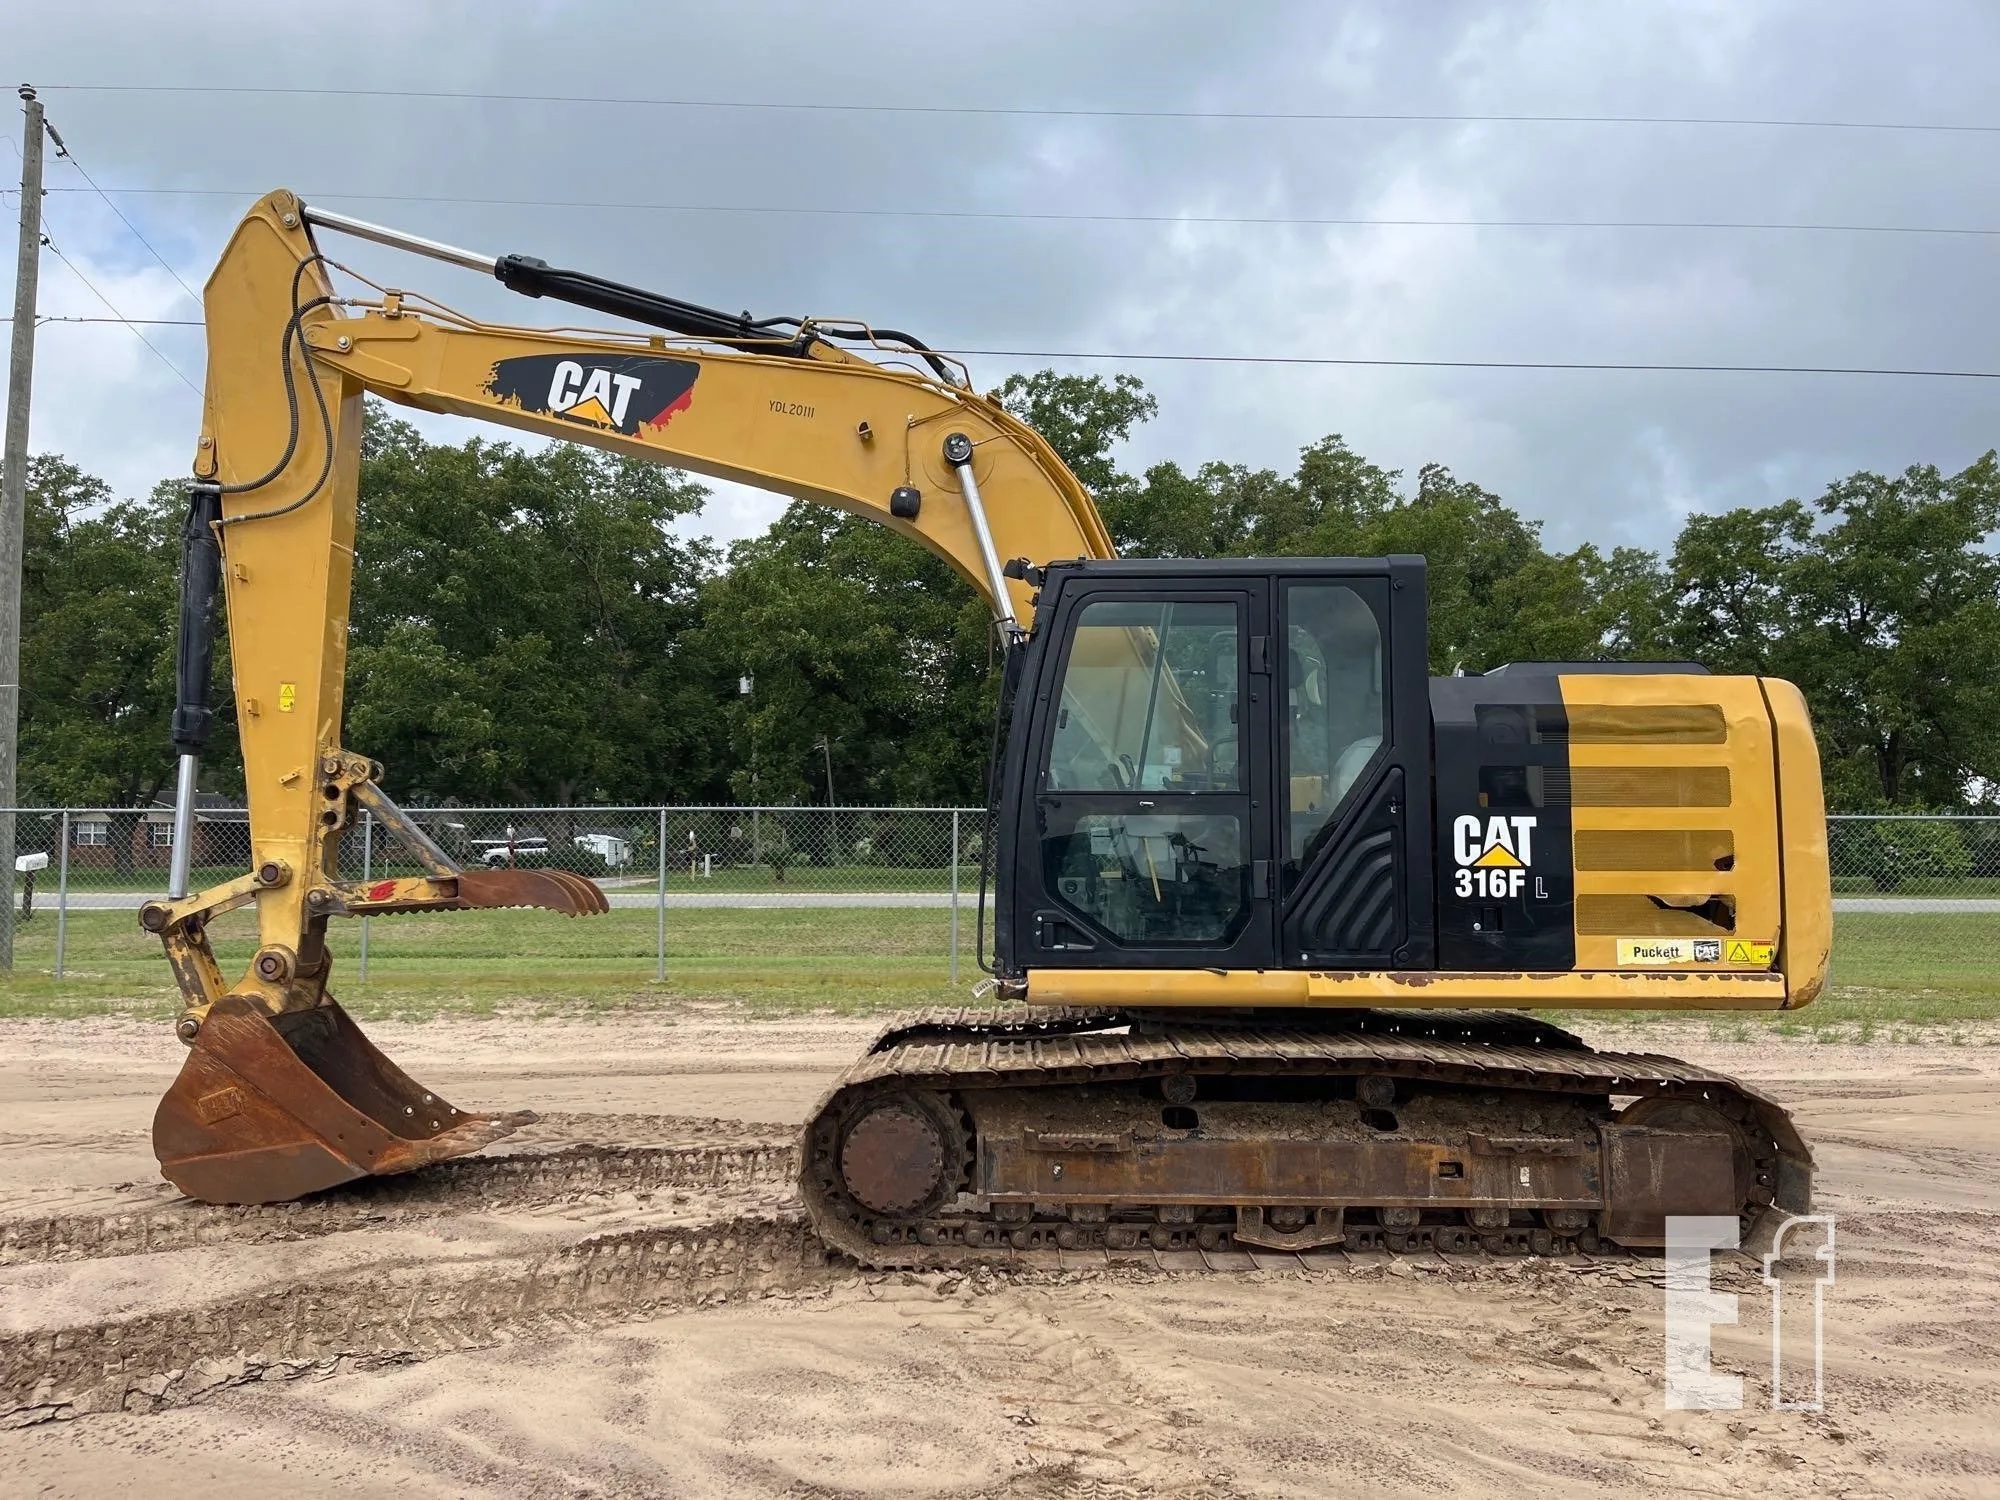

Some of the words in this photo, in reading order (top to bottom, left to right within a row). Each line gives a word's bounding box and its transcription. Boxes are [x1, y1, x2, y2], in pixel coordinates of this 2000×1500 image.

[548, 361, 642, 427] CAT
[1454, 815, 1537, 867] CAT
[1455, 869, 1526, 898] 316F
[1535, 876, 1548, 898] L
[1633, 946, 1680, 959] Puckett
[1695, 945, 1720, 959] CAT
